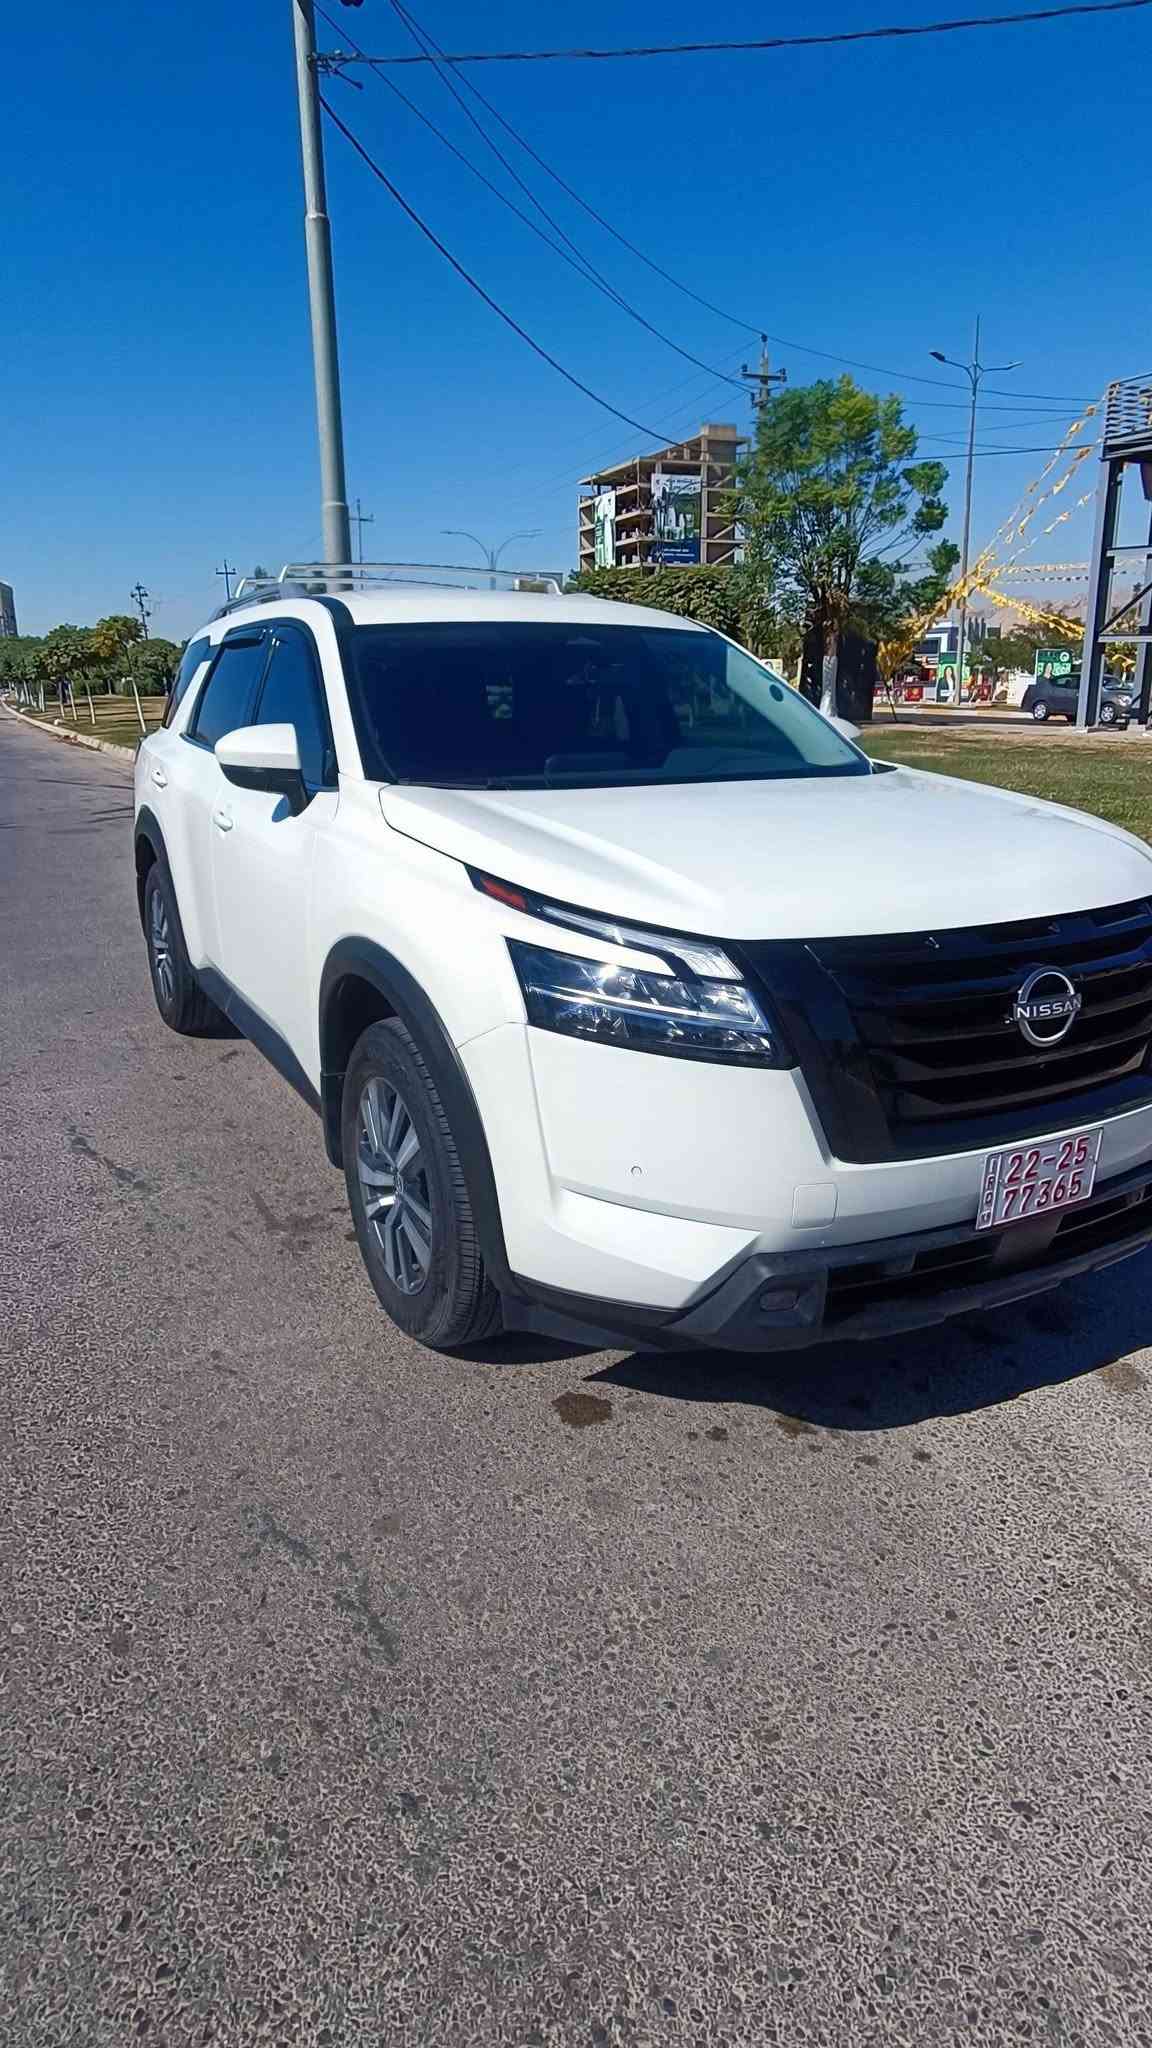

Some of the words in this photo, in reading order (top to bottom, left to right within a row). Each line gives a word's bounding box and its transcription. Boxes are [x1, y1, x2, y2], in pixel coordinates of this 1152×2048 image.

[1017, 998, 1081, 1018] NISSAN
[1005, 1136, 1089, 1184] 22-25
[1002, 1168, 1084, 1217] 77365
